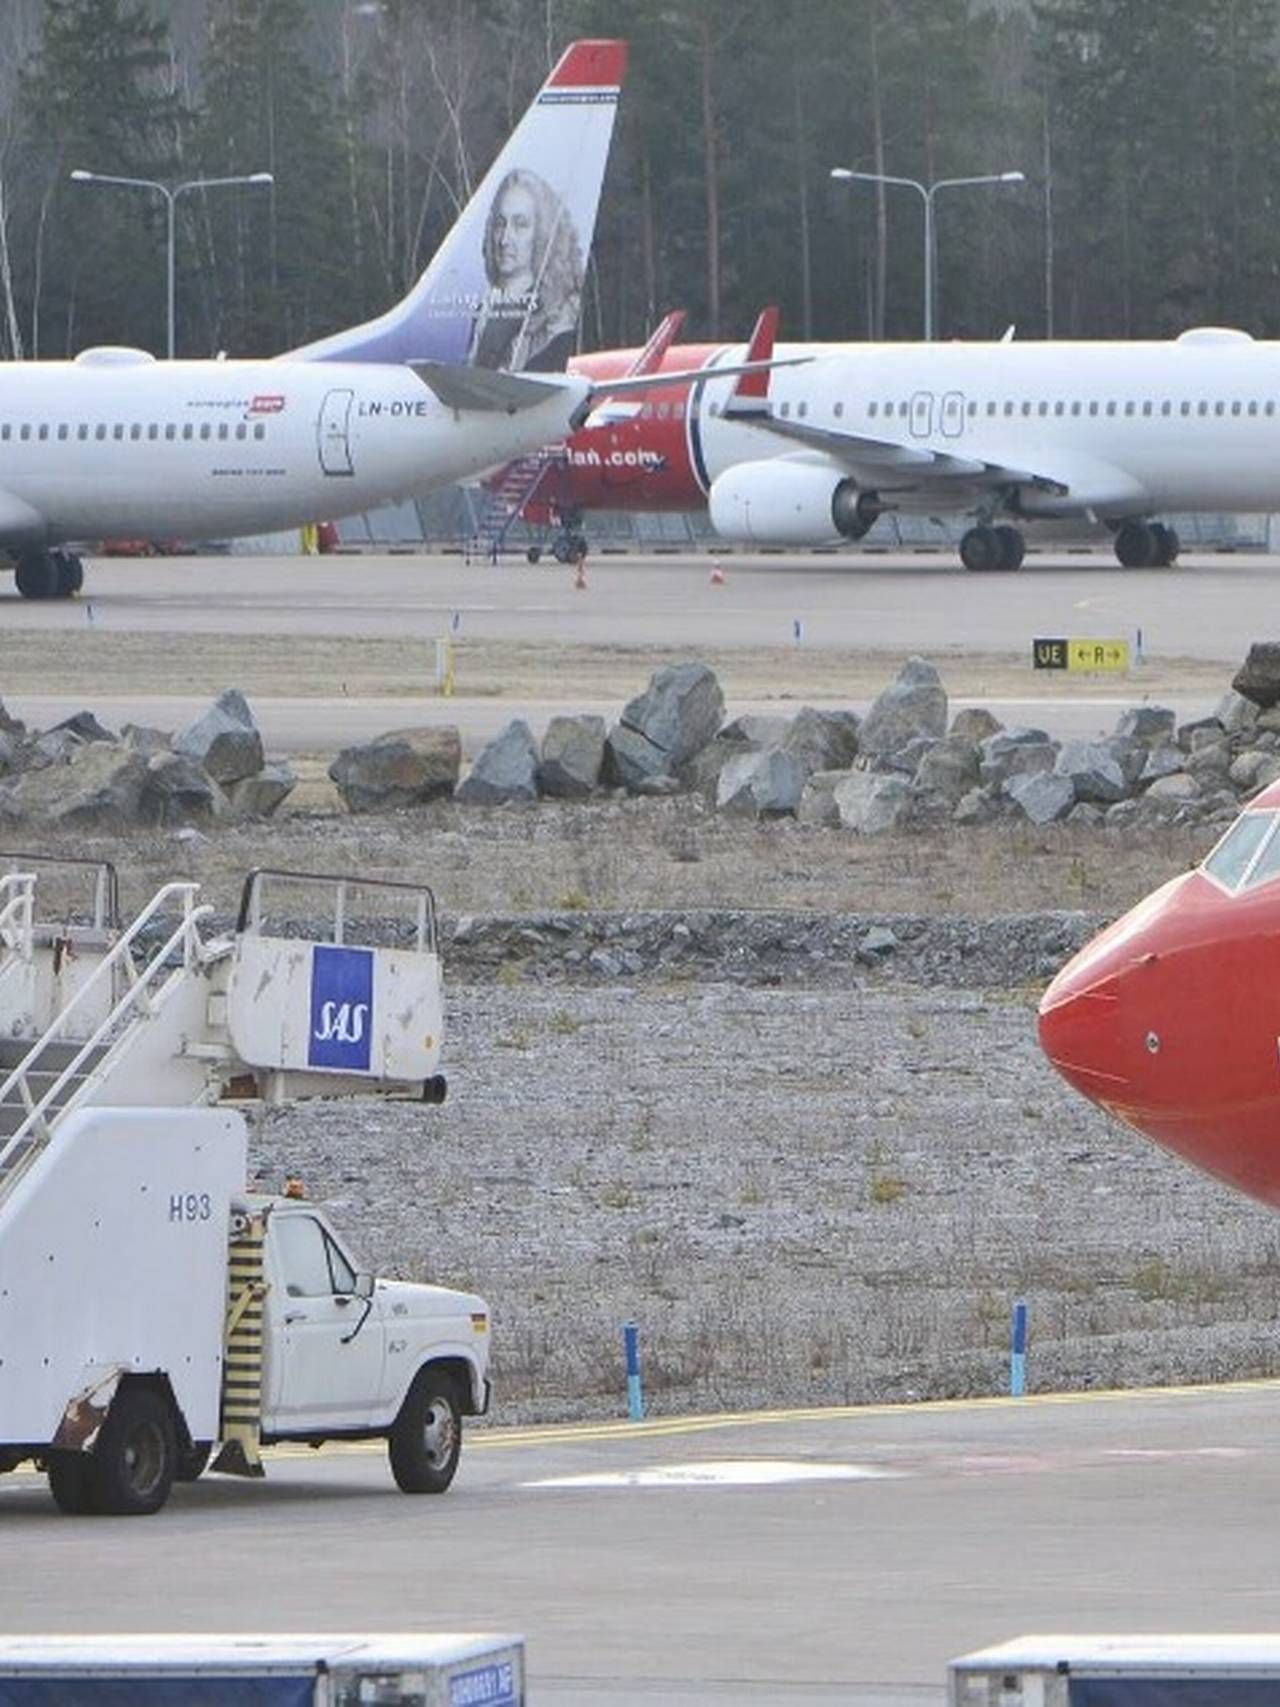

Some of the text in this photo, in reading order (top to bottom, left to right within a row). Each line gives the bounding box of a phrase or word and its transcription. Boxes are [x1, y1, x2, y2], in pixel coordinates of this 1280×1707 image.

[1094, 646, 1105, 665] R
[315, 1001, 368, 1043] SAS
[169, 1194, 211, 1223] H93
